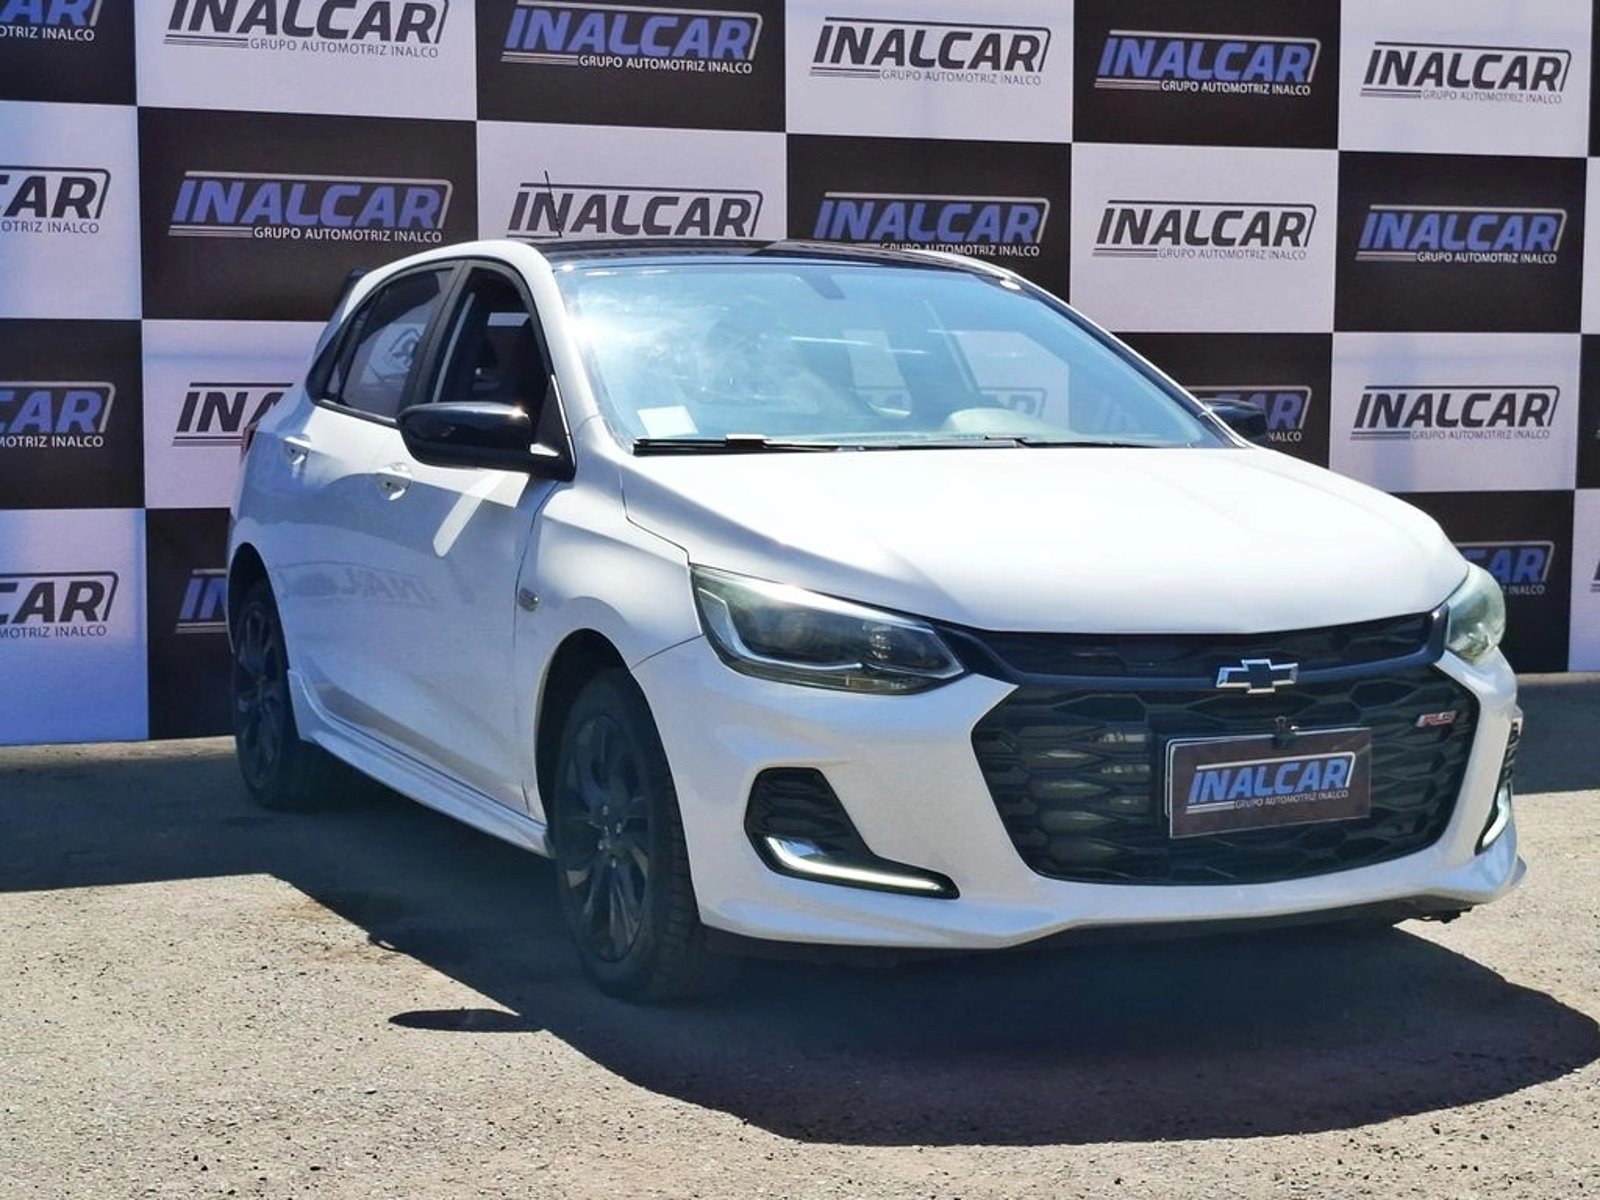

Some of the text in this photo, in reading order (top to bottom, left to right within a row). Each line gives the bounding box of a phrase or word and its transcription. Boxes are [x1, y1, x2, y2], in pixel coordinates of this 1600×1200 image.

[168, 0, 437, 43] INALCAR
[42, 27, 95, 41] INALCO
[505, 8, 752, 60] INALCAR
[250, 38, 439, 58] GRUPO AUTOMOTRIZ INALCO
[813, 25, 1041, 72] INALCAR
[579, 55, 753, 74] GRUPO AUTOMOTRIZ INALCO
[1097, 37, 1311, 83] INALCAR
[881, 70, 1042, 86] GRUPO AUTOMOTRIZ INALCO
[1363, 49, 1562, 91] INALCAR
[1161, 80, 1311, 95] GRUPO AUTOMOTRIZ INALCO
[1422, 89, 1562, 104] GRUPO AUTOMOTRIZ INALCO
[171, 180, 441, 229] INALCAR
[507, 191, 753, 237] INALCAR
[47, 222, 99, 234] INALCO
[813, 199, 1040, 243] INALCAR
[1096, 207, 1307, 248] INALCAR
[254, 226, 442, 243] GRUPO AUTOMOTRIZ INALCO
[1358, 211, 1559, 252] INALCAR
[999, 245, 1040, 257] INALCO
[1158, 249, 1307, 261] GRUPO AUTOMOTRIZ INALCO
[1417, 252, 1558, 265] GRUPO AUTOMOTRIZ INALCO
[1353, 392, 1550, 429] INALCAR
[51, 435, 104, 448] INALCO
[1412, 430, 1550, 441] GRUPO AUTOMOTRIZ INALCO
[55, 625, 107, 638] INALCO
[1188, 757, 1350, 804] INALCAR
